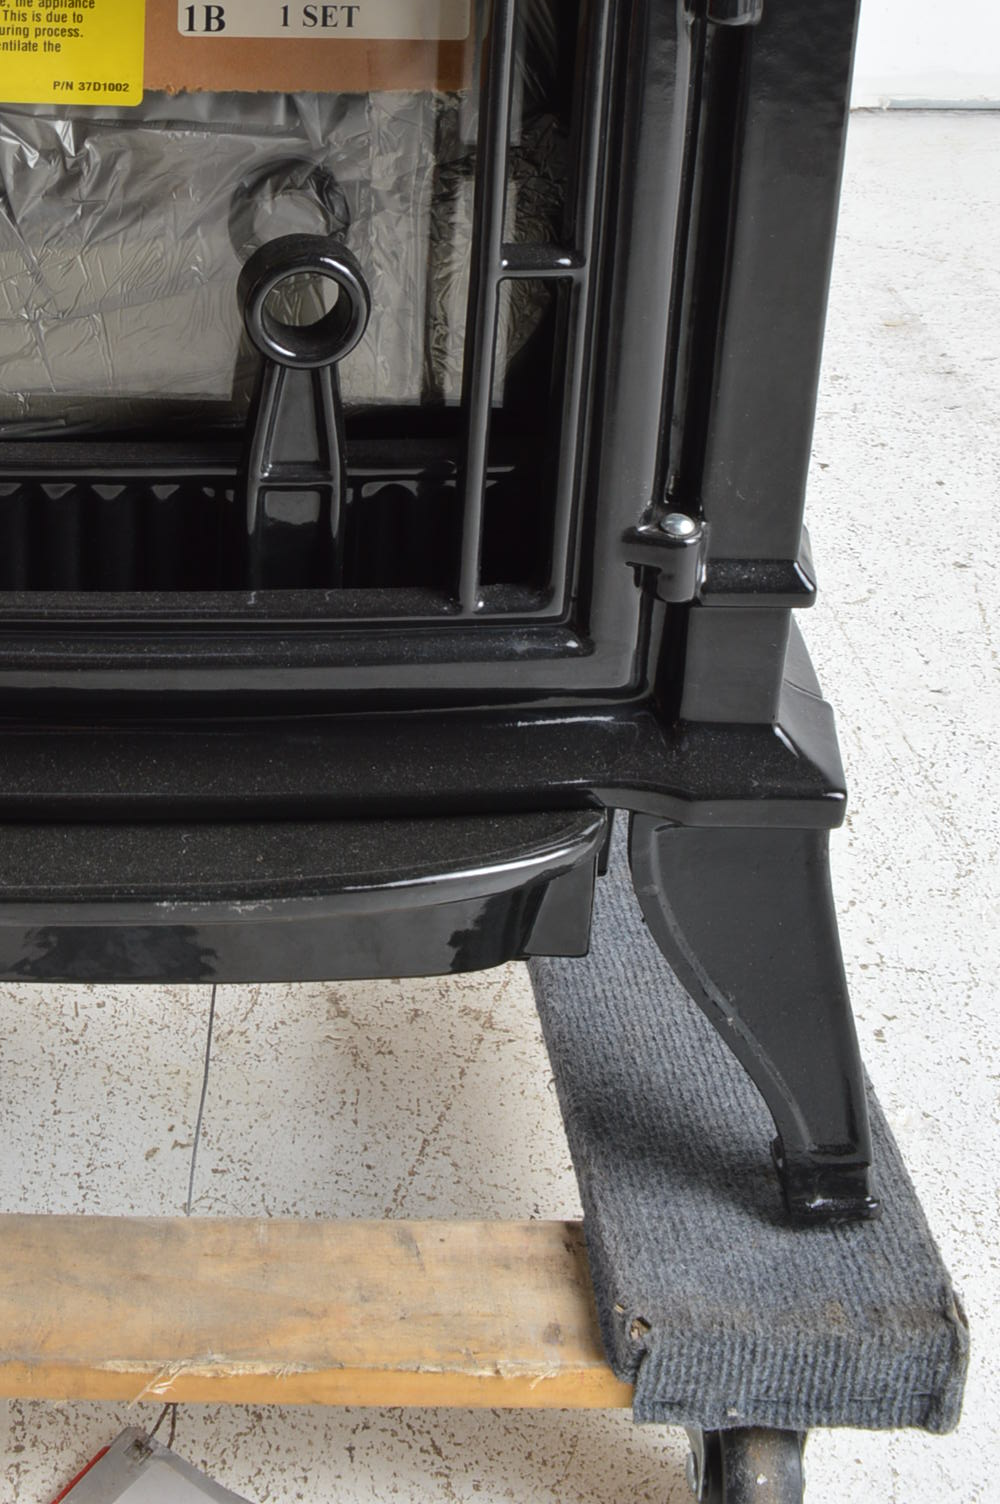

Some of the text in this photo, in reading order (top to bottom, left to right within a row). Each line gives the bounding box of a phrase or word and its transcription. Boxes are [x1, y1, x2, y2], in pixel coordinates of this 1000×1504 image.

[2, 9, 27, 22] This
[32, 13, 42, 23] is
[46, 10, 68, 23] due
[72, 12, 83, 24] to
[184, 4, 227, 32] 1B
[280, 5, 361, 28] 1 SET
[34, 27, 83, 38] process.
[43, 40, 61, 53] the
[53, 81, 129, 92] P/N 37D1002
